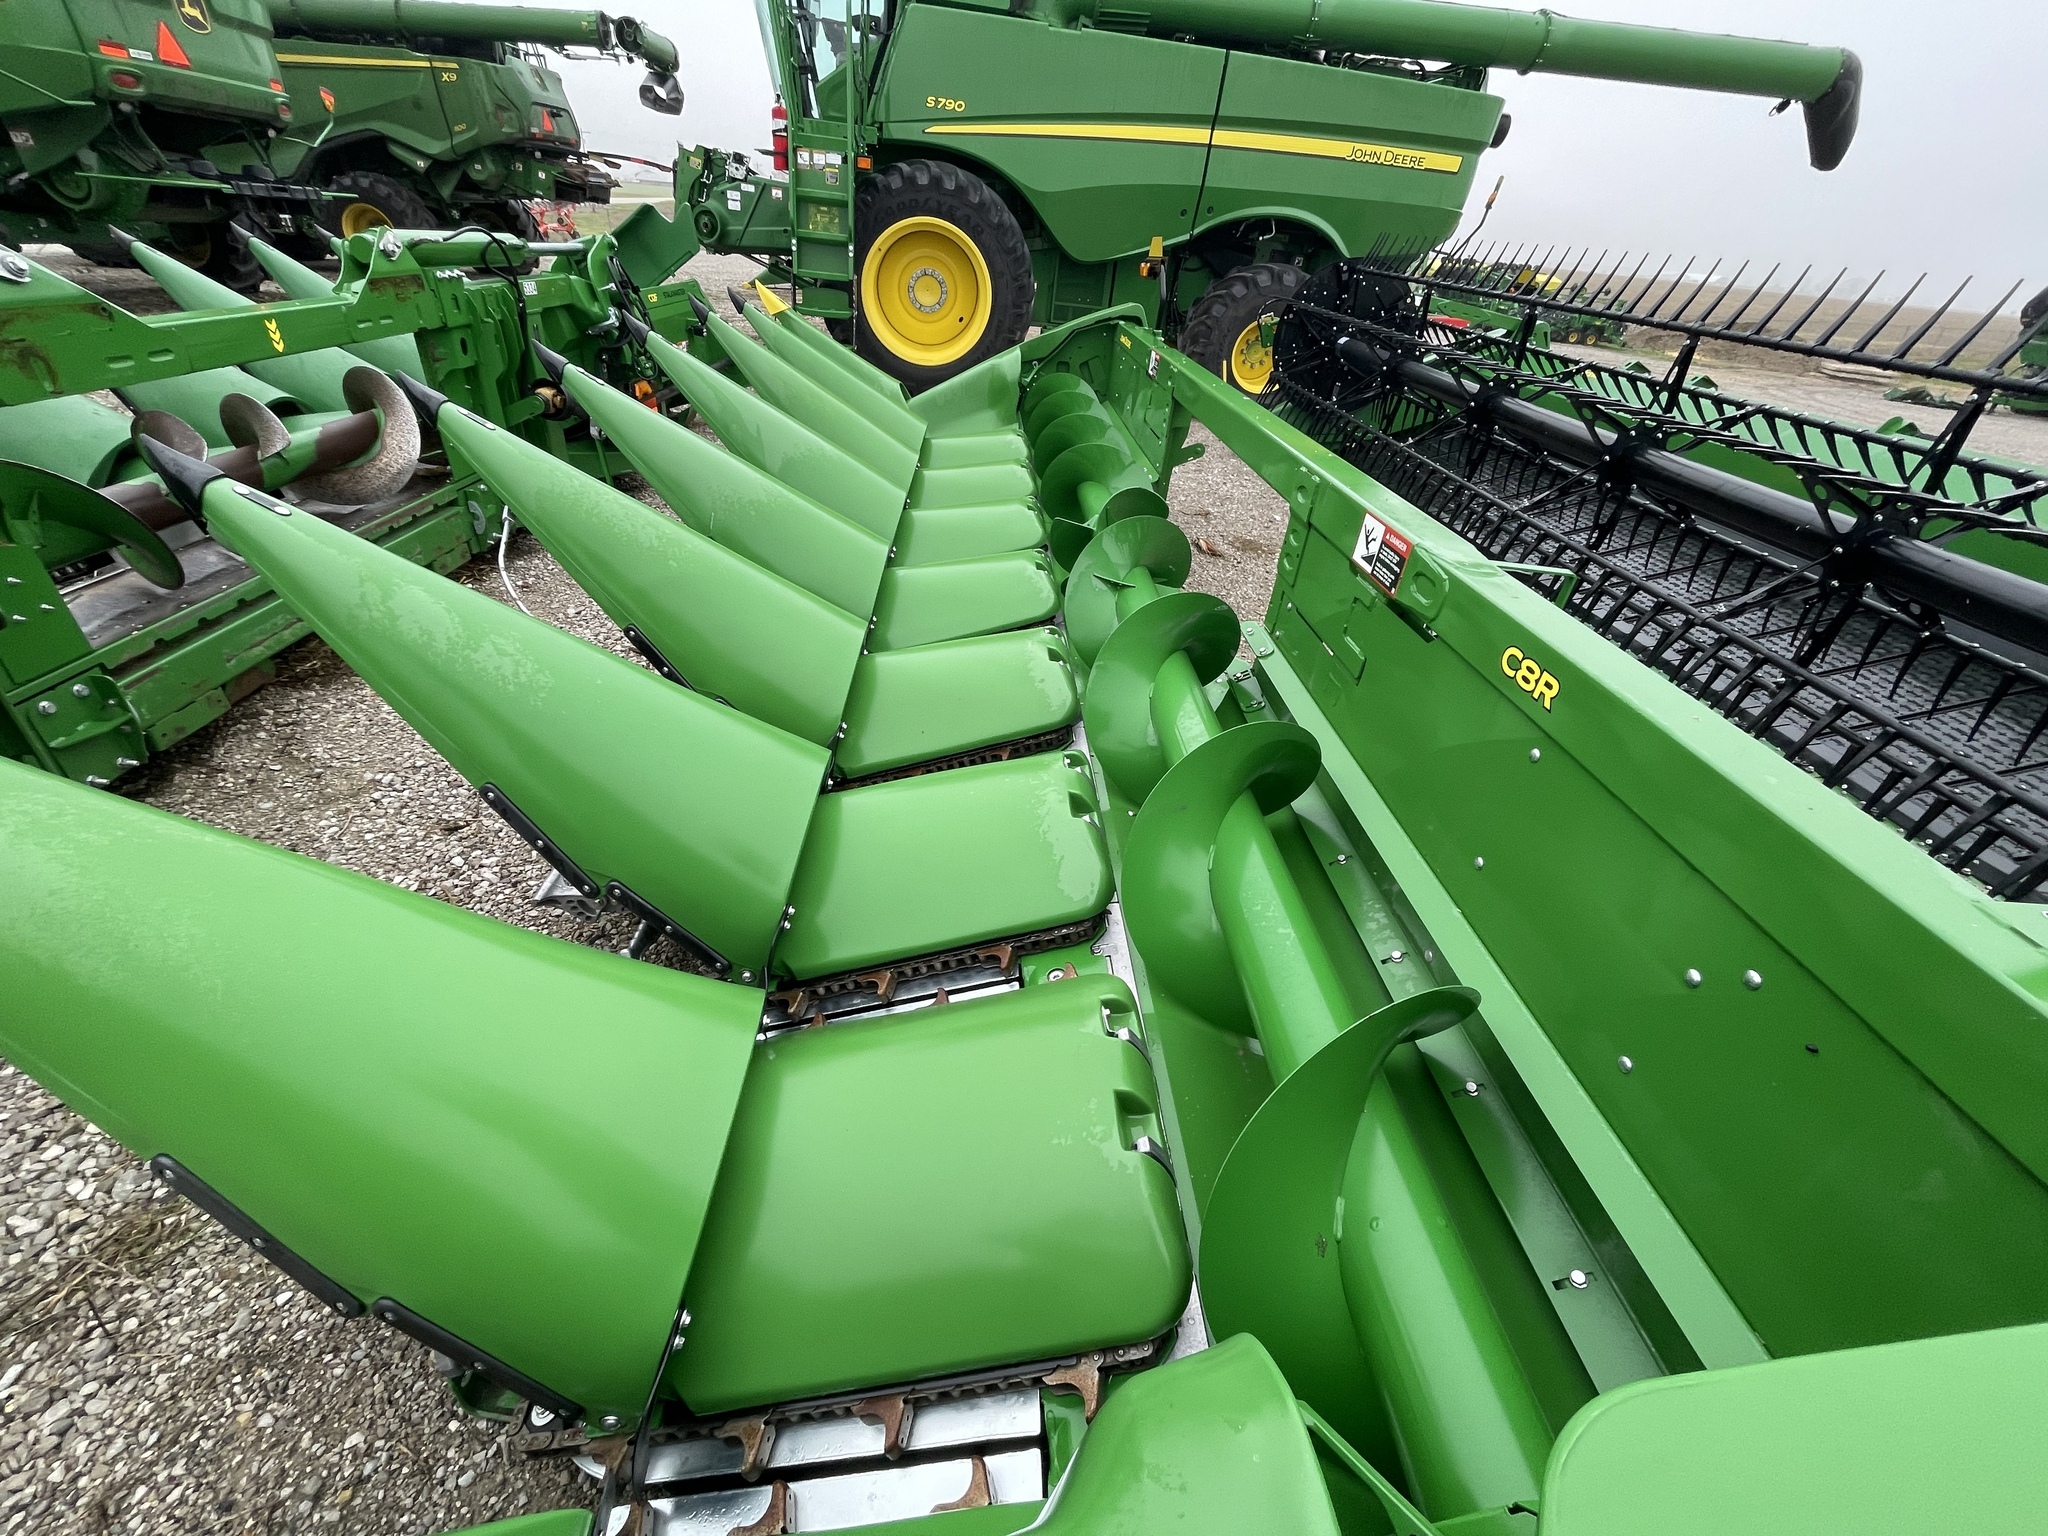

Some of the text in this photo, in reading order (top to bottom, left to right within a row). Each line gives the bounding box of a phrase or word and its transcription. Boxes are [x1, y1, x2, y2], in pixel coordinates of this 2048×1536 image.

[441, 71, 458, 83] X9
[925, 95, 966, 112] S790
[1345, 145, 1426, 167] JOHN DEERE
[1389, 533, 1408, 553] DANGER
[1500, 645, 1561, 714] C8R
